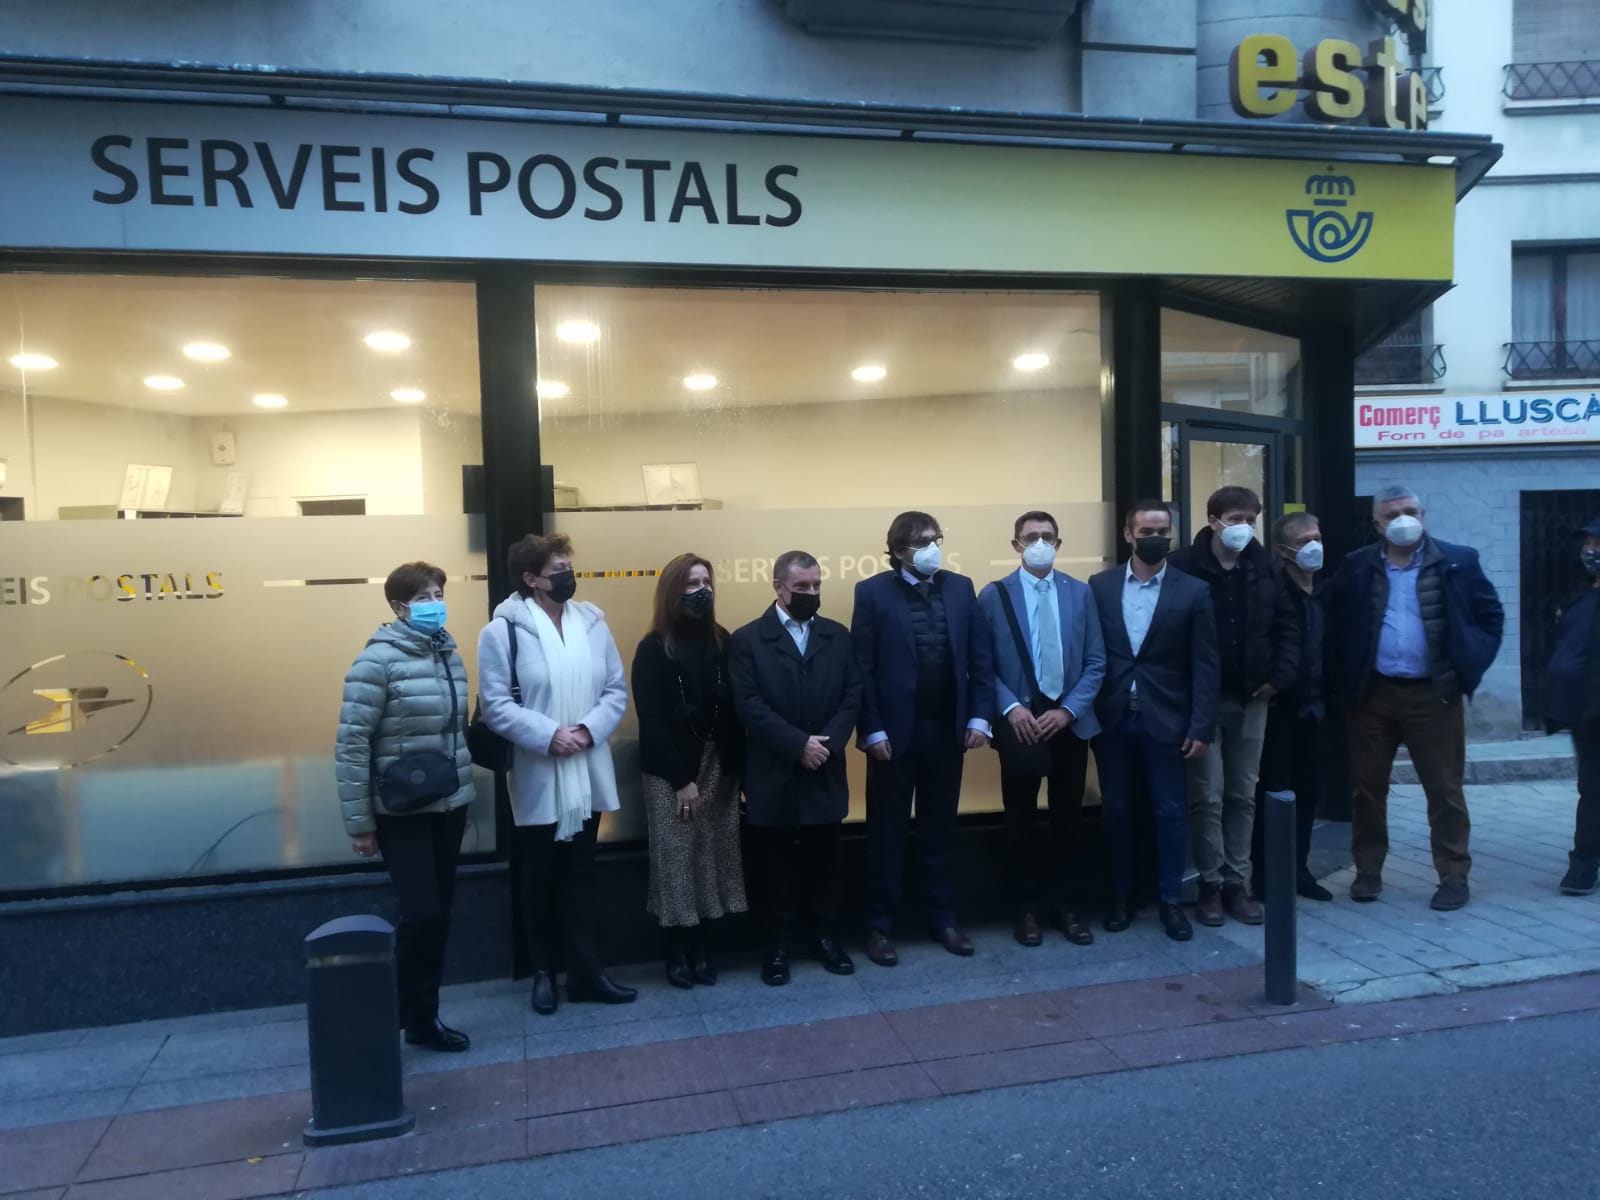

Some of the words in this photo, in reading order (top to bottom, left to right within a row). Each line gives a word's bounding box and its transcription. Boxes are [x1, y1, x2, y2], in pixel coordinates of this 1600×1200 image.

[90, 133, 440, 215] SERVEIS
[467, 151, 802, 227] POSTALS
[1358, 403, 1442, 430] Comerç
[1377, 430, 1426, 441] Forn
[1438, 428, 1466, 439] de
[1478, 428, 1506, 440] pa
[62, 571, 225, 603] POSTALS
